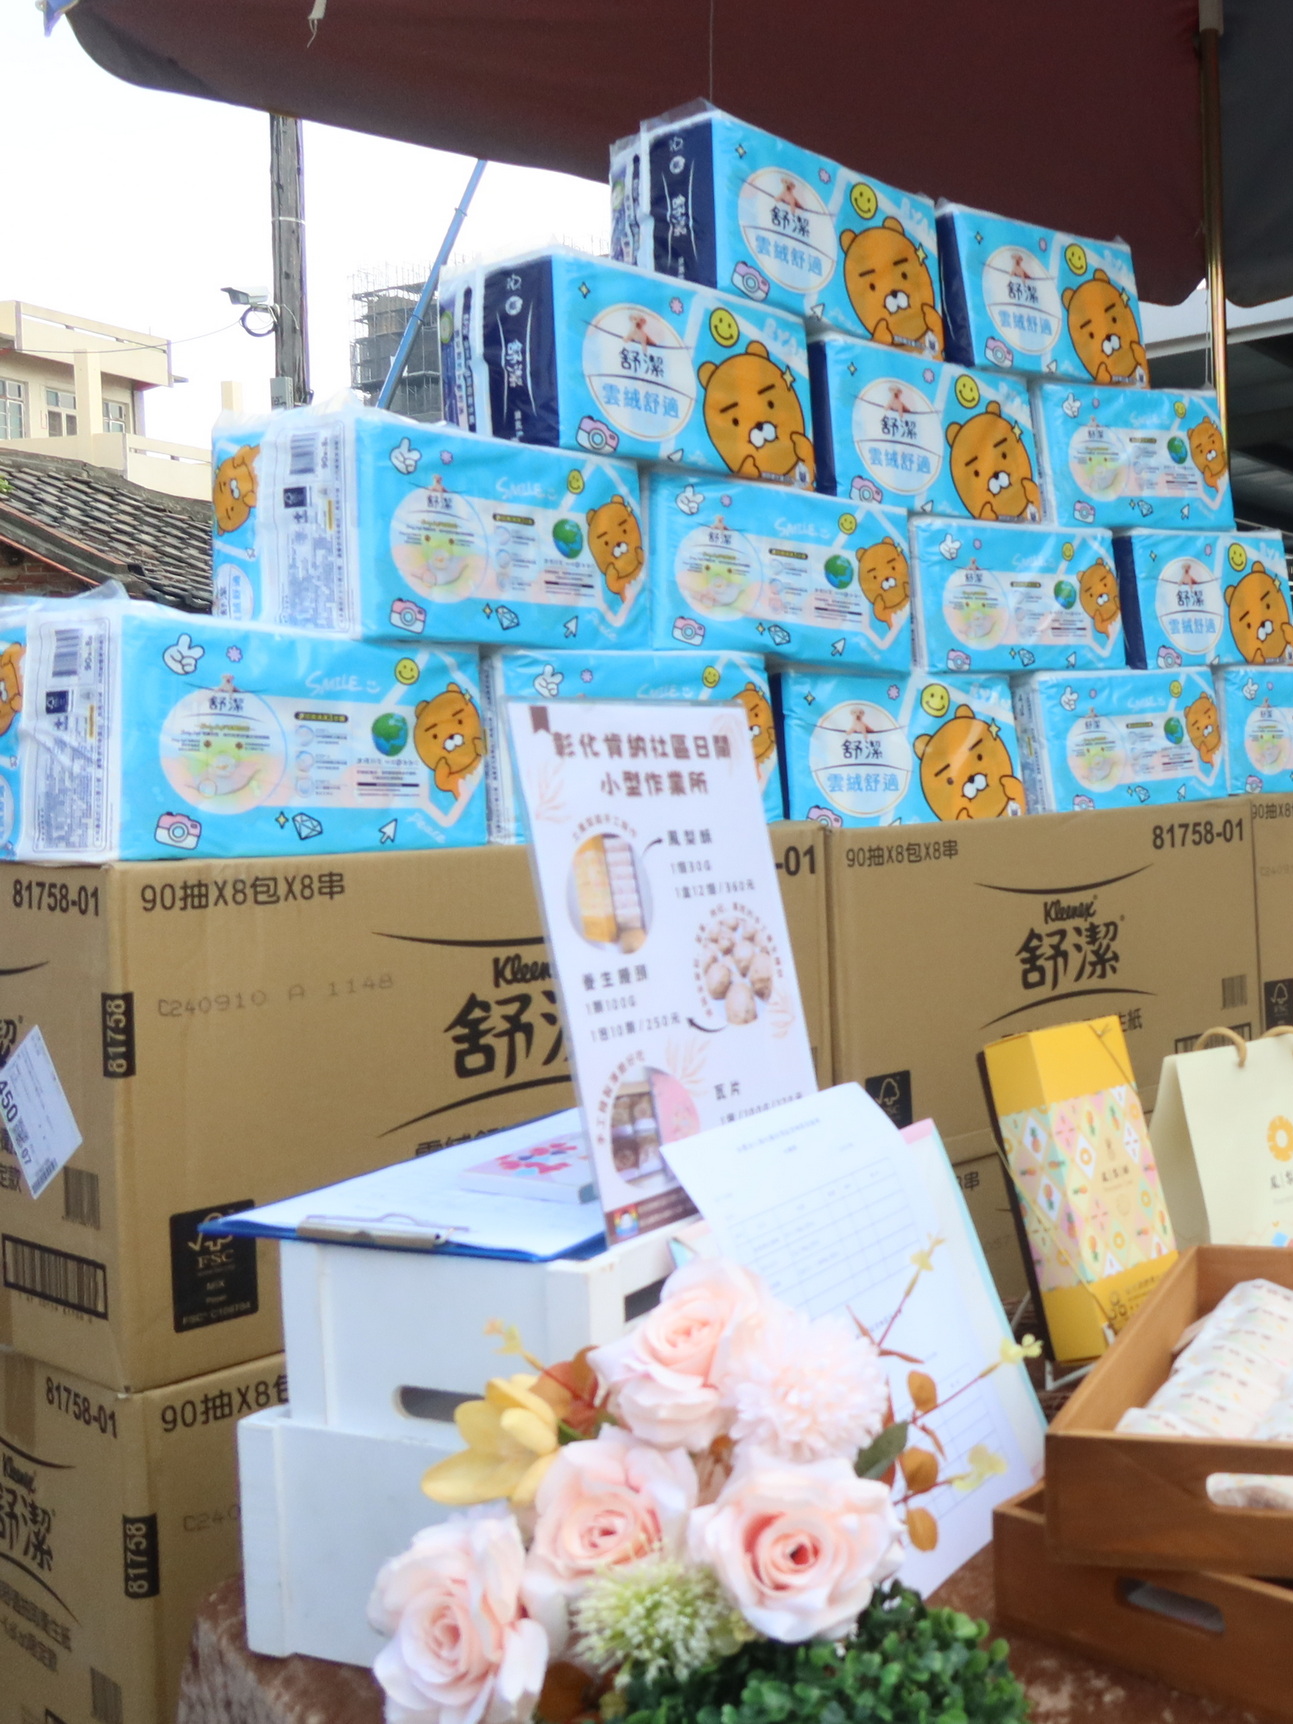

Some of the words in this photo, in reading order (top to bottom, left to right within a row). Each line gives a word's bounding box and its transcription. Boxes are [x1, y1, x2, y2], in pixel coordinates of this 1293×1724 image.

[770, 206, 811, 239] 舒潔
[754, 234, 823, 277] 雲絨舒適
[1007, 279, 1039, 303] 舒潔
[618, 347, 666, 379] 舒潔
[602, 382, 681, 420] 雲絨舒適
[880, 415, 917, 441] 舒潔
[868, 446, 932, 475] 雲絨舒適
[1176, 589, 1205, 608] 舒潔
[208, 695, 245, 713] 舒潔
[842, 738, 884, 761] 舒潔
[600, 770, 708, 797] 小型作業所
[827, 772, 900, 794] 雲絨舒適
[667, 828, 713, 847] 鳳梨酥
[1152, 818, 1246, 851] 81758-01
[845, 839, 960, 870] 90抽X8包X8串
[12, 879, 100, 917] 81758-01
[140, 871, 346, 912] 90抽X8包X8串
[1044, 898, 1097, 924] Kleenex
[493, 954, 553, 988] Kleen
[1015, 920, 1121, 991] 舒潔
[582, 963, 648, 991] 養生饅頭
[157, 988, 267, 1018] C240910
[328, 973, 394, 998] 1148
[105, 998, 128, 1074] 81758
[197, 1250, 235, 1269] FSC
[46, 1376, 118, 1438] 81758-01
[126, 1521, 149, 1595] 81758
